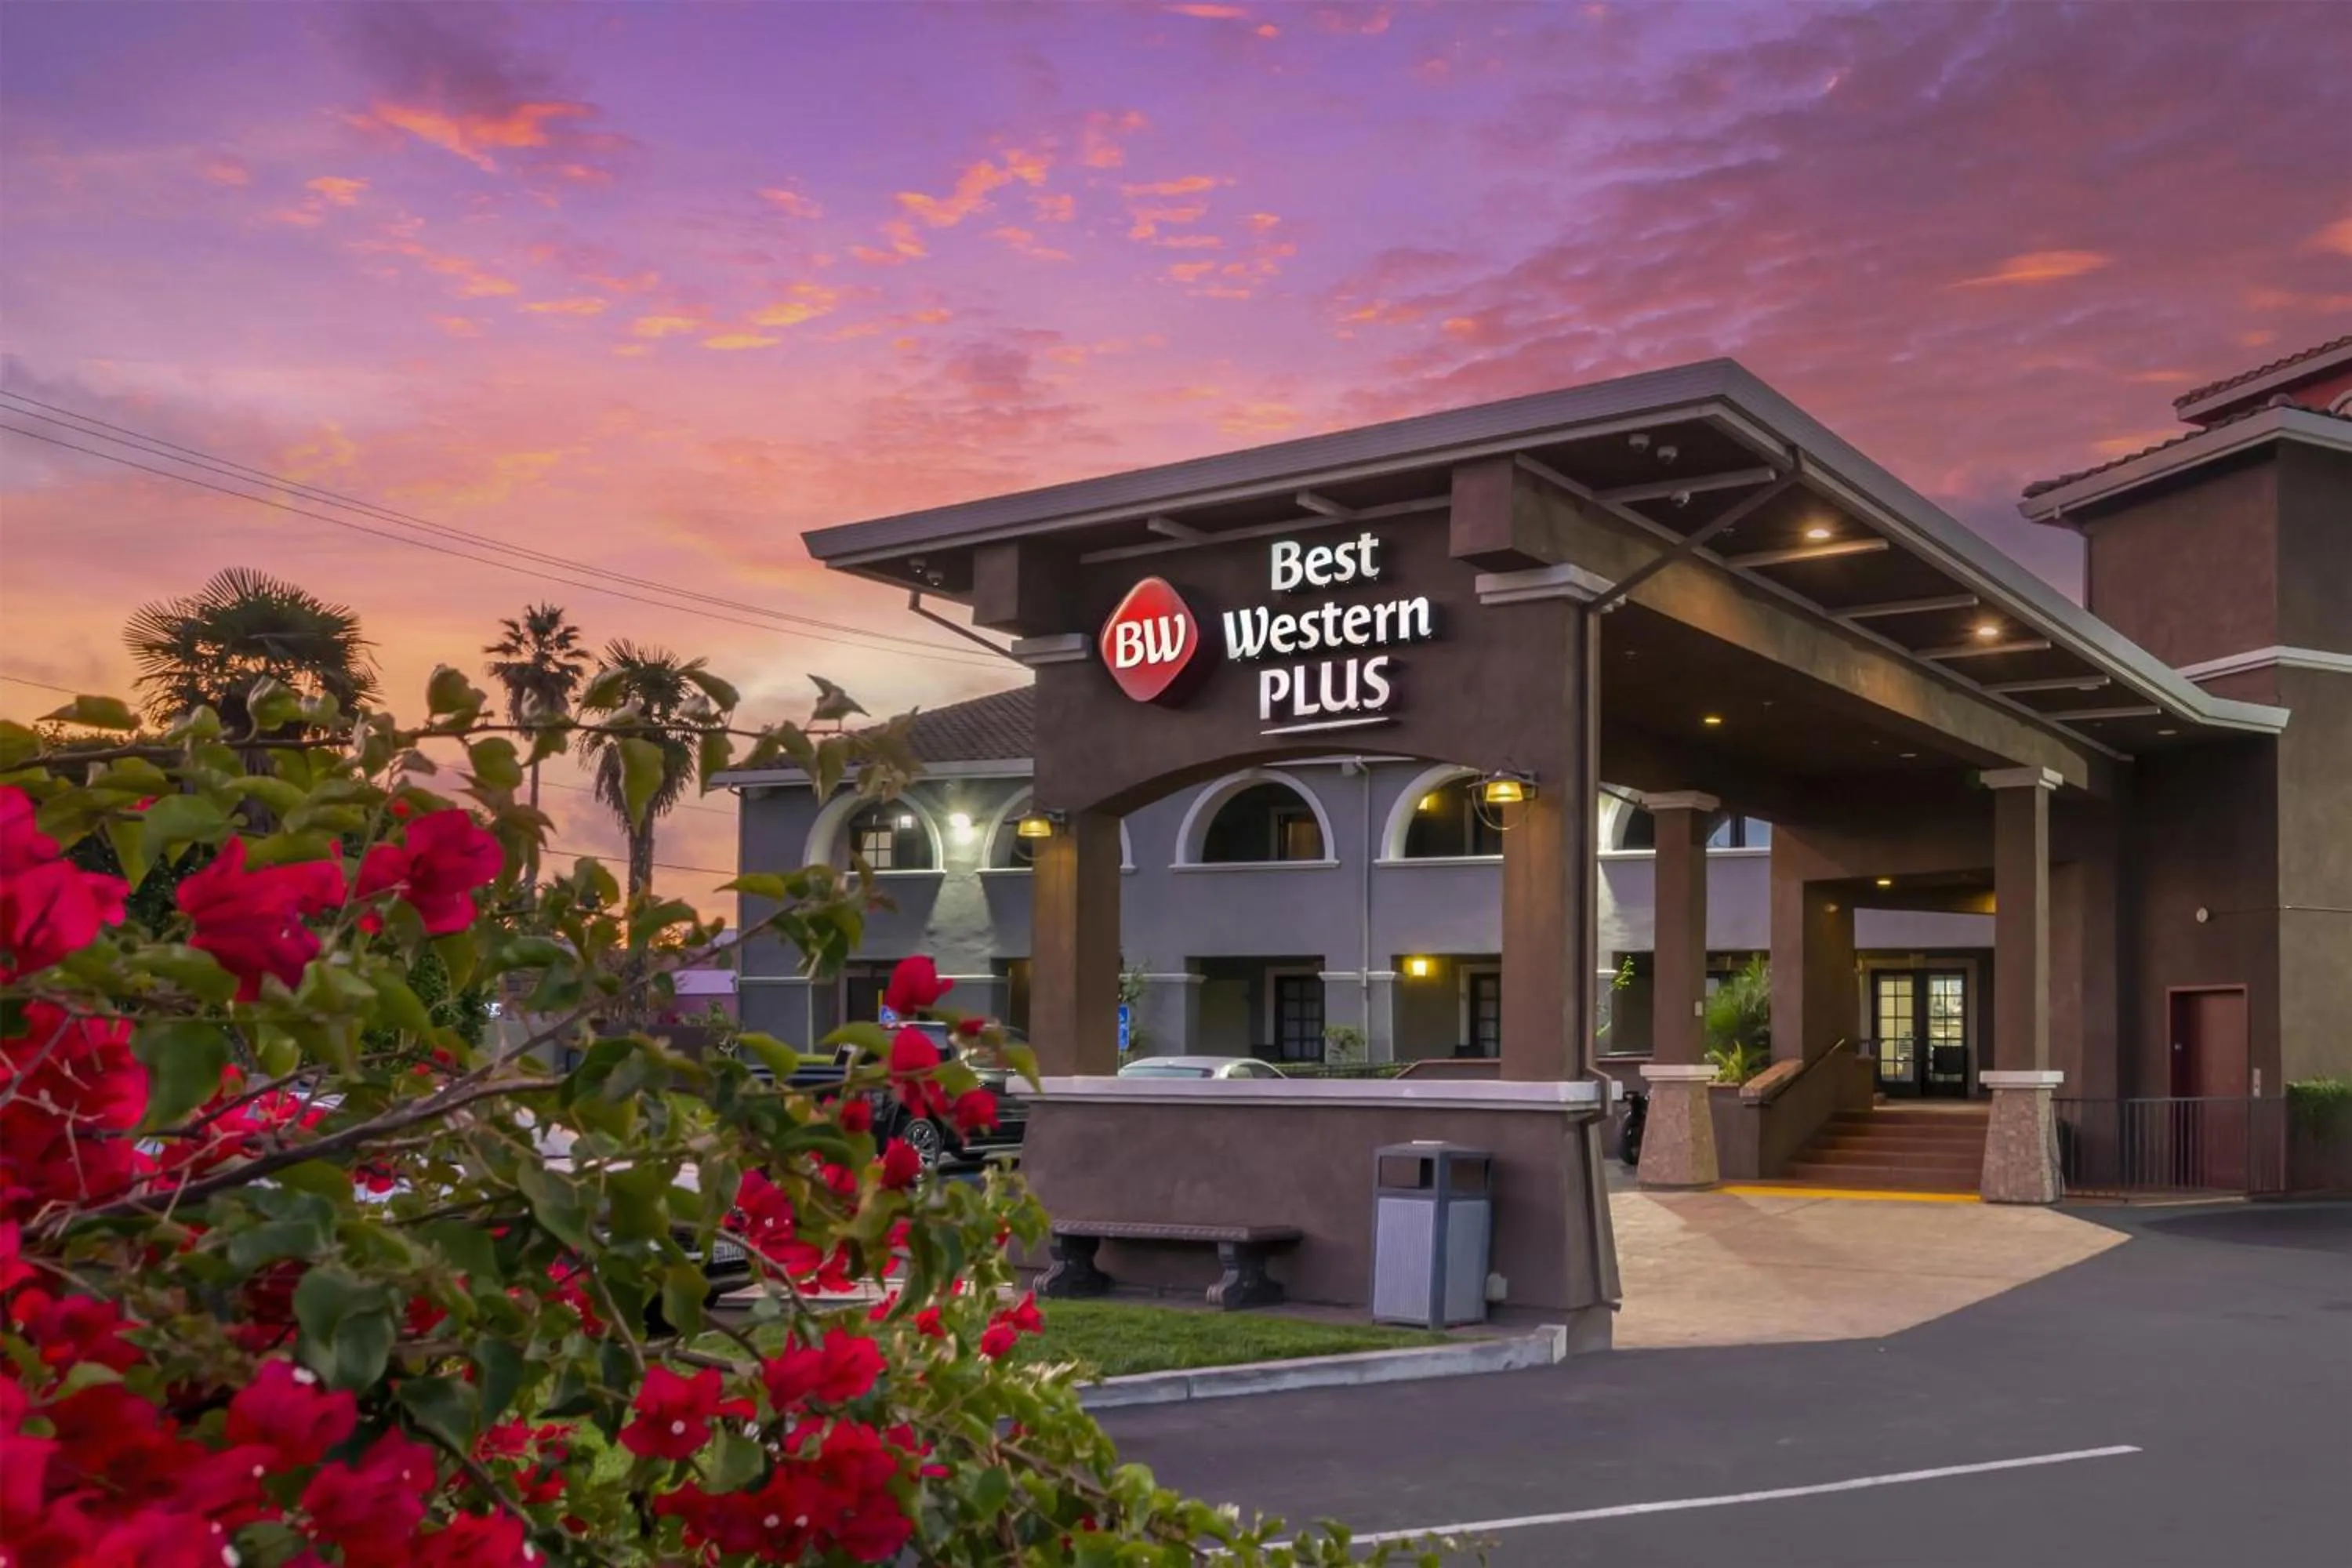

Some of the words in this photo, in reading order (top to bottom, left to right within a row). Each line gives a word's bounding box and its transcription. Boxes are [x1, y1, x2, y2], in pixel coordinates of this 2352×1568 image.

[1271, 532, 1381, 591] Best
[1116, 612, 1186, 669] BW
[1222, 596, 1432, 660] Western
[1259, 655, 1391, 720] PLUS
